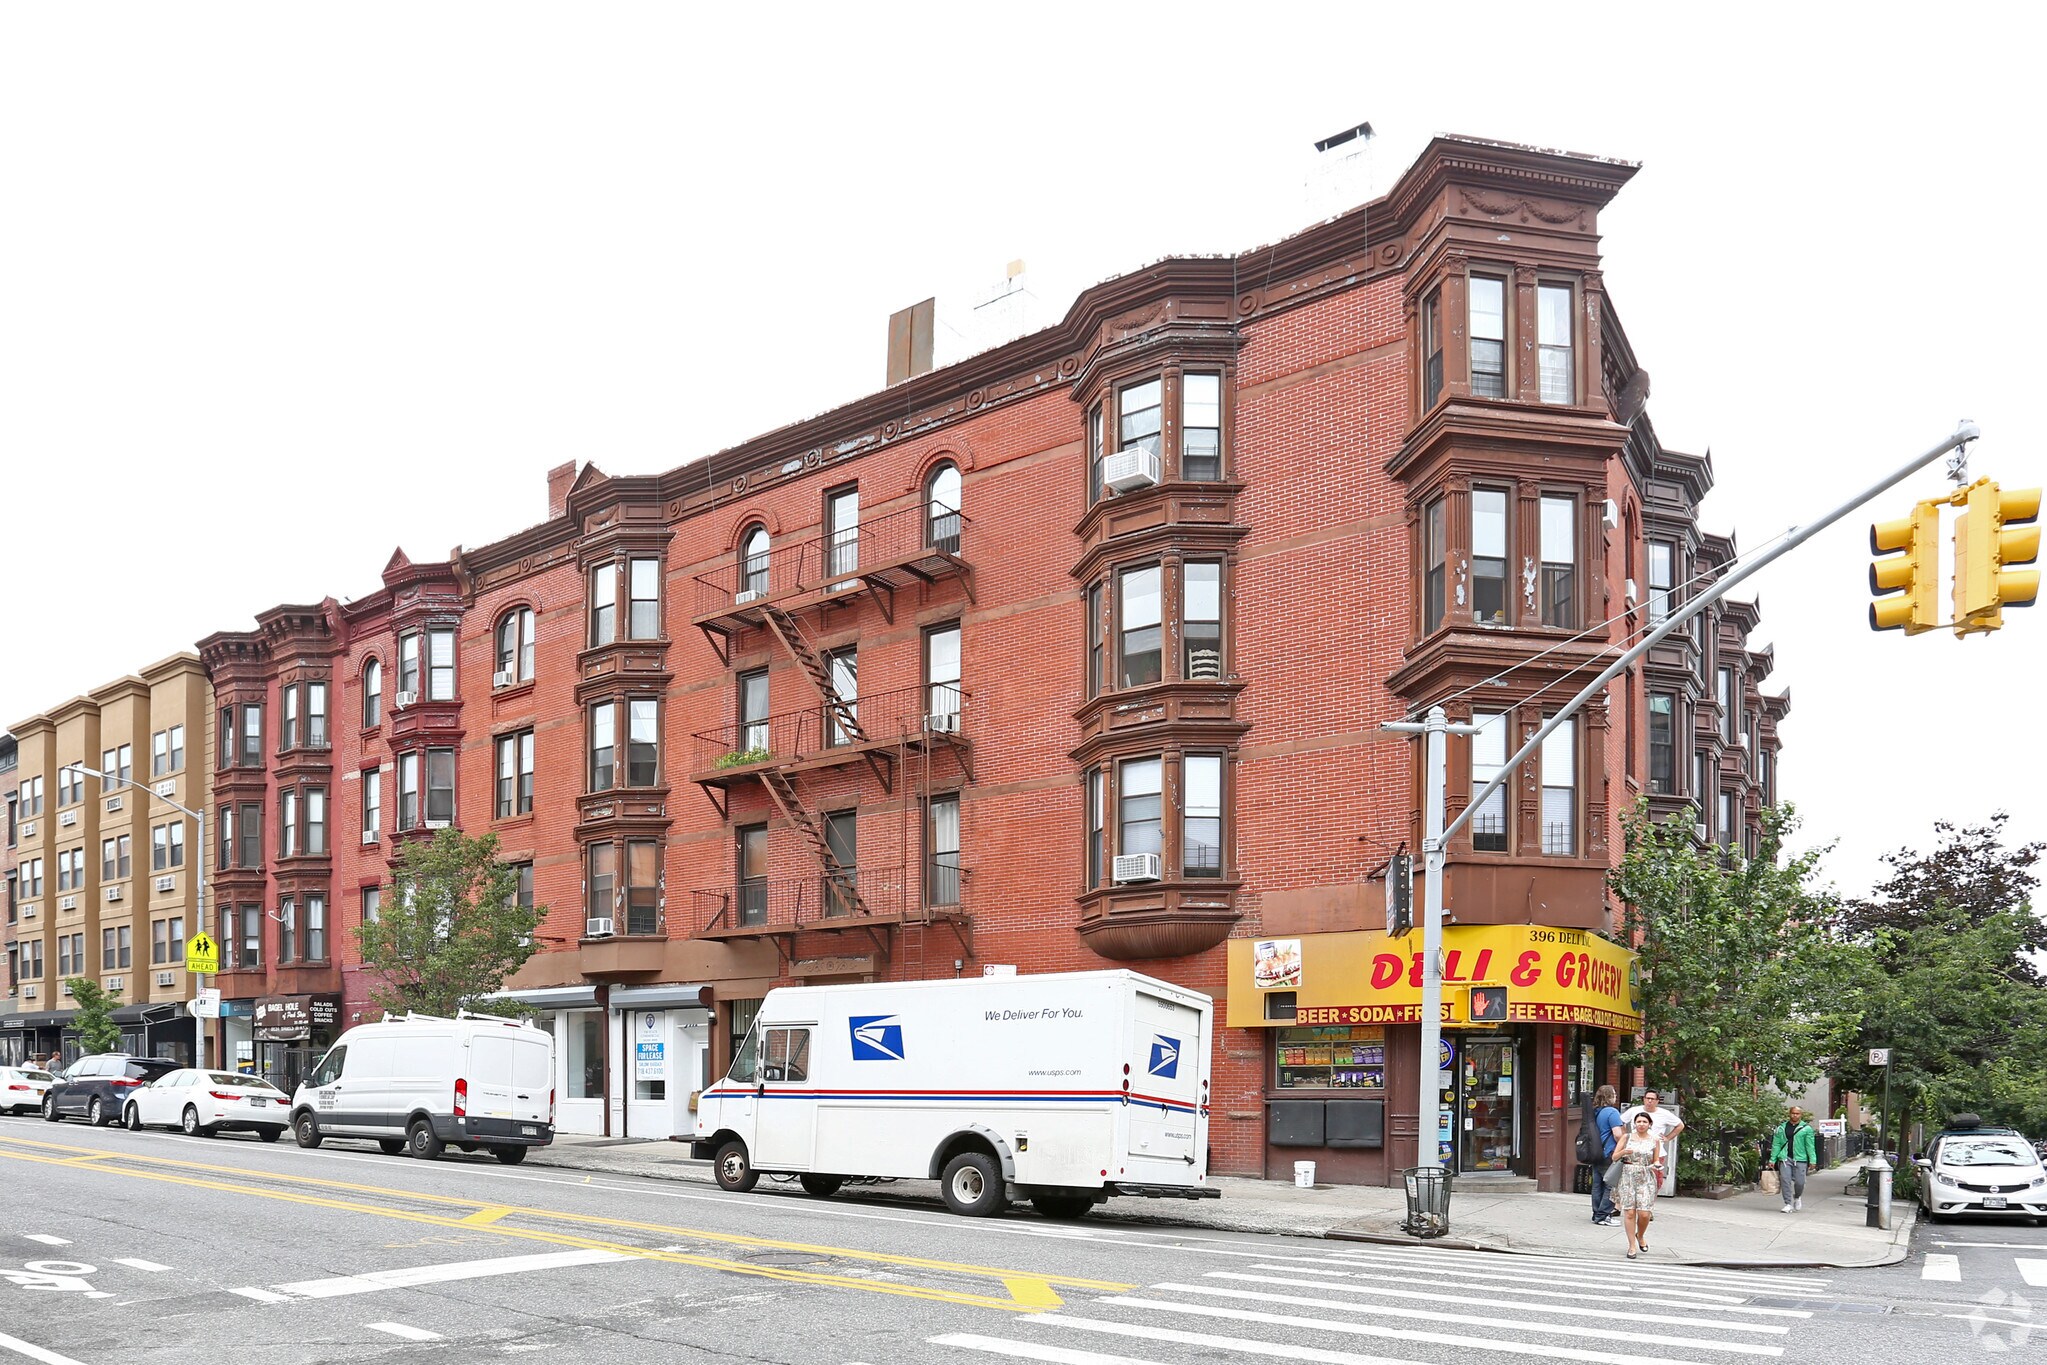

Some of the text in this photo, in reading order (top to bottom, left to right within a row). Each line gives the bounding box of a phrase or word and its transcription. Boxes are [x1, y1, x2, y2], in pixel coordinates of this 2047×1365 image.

[1529, 930, 1555, 942] 396
[1559, 932, 1580, 945] DELI
[191, 963, 214, 971] AHEAD
[1510, 950, 1542, 987] &
[1556, 951, 1622, 1000] GROCERY
[268, 1002, 299, 1012] BAGEL HOLE
[985, 1007, 1084, 1021] We Deliver For You.
[1297, 1008, 1340, 1024] BEER
[1349, 1007, 1395, 1023] SODA
[1545, 1005, 1570, 1021] TEA
[1573, 1007, 1593, 1024] BAGEL
[641, 1043, 659, 1052] SPACE
[647, 1052, 663, 1060] LEASE
[1028, 1069, 1082, 1078] www.usps.com
